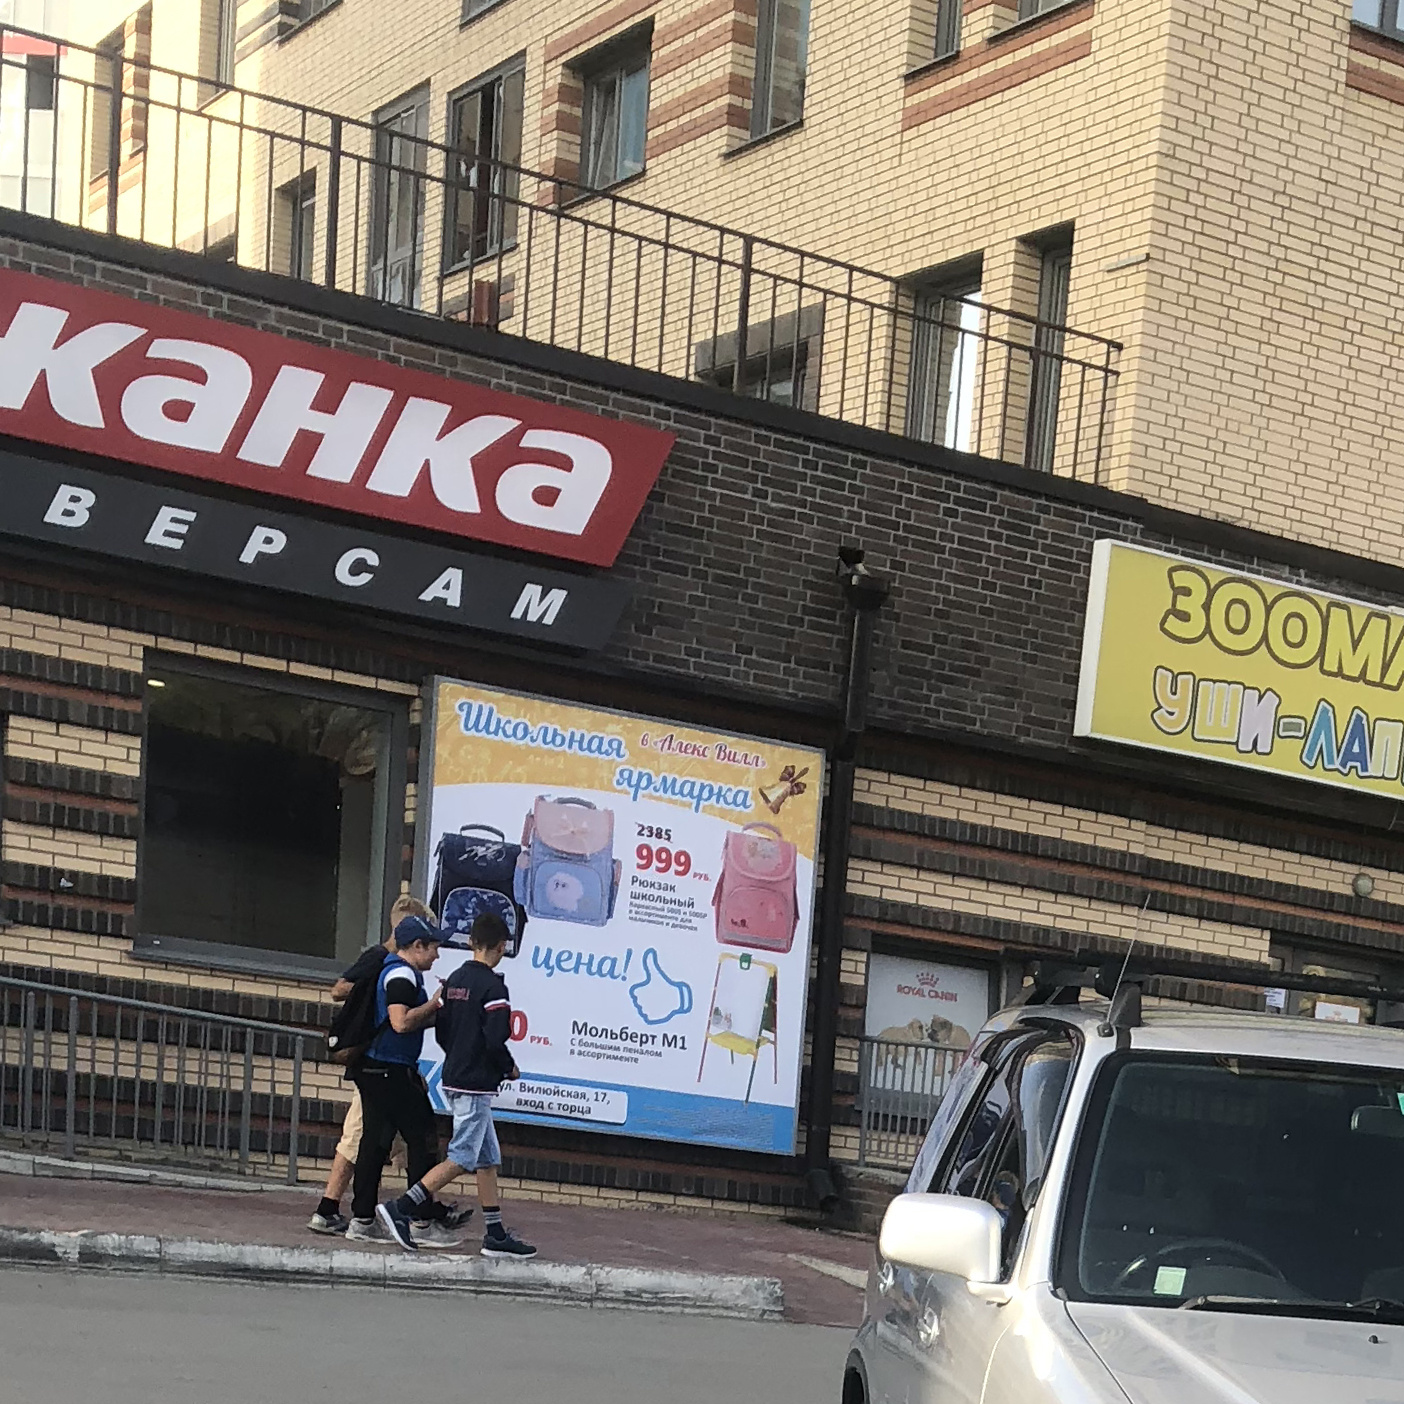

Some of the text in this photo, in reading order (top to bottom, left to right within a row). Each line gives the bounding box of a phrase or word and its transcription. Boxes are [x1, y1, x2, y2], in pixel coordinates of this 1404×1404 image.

[43, 483, 568, 625] ВЕРСАМ
[457, 701, 626, 759] Школьная
[640, 732, 649, 747] в
[615, 767, 752, 814] ярмарка
[635, 823, 673, 842] 2385
[635, 843, 692, 877] 999
[630, 875, 677, 893] Рюкзак
[629, 890, 695, 909] школьный
[531, 945, 633, 981] цена!
[896, 983, 958, 1003] ROYAL CANIN
[529, 1035, 553, 1046] РУБ.
[571, 1020, 688, 1050] Мольберт М1
[576, 1049, 640, 1065] ассортименте
[577, 1037, 621, 1052] большим
[622, 1045, 663, 1058] пеналом
[518, 1082, 591, 1103] Вилюйская,
[593, 1090, 611, 1105] 17,
[515, 1098, 592, 1116] вход с торца
